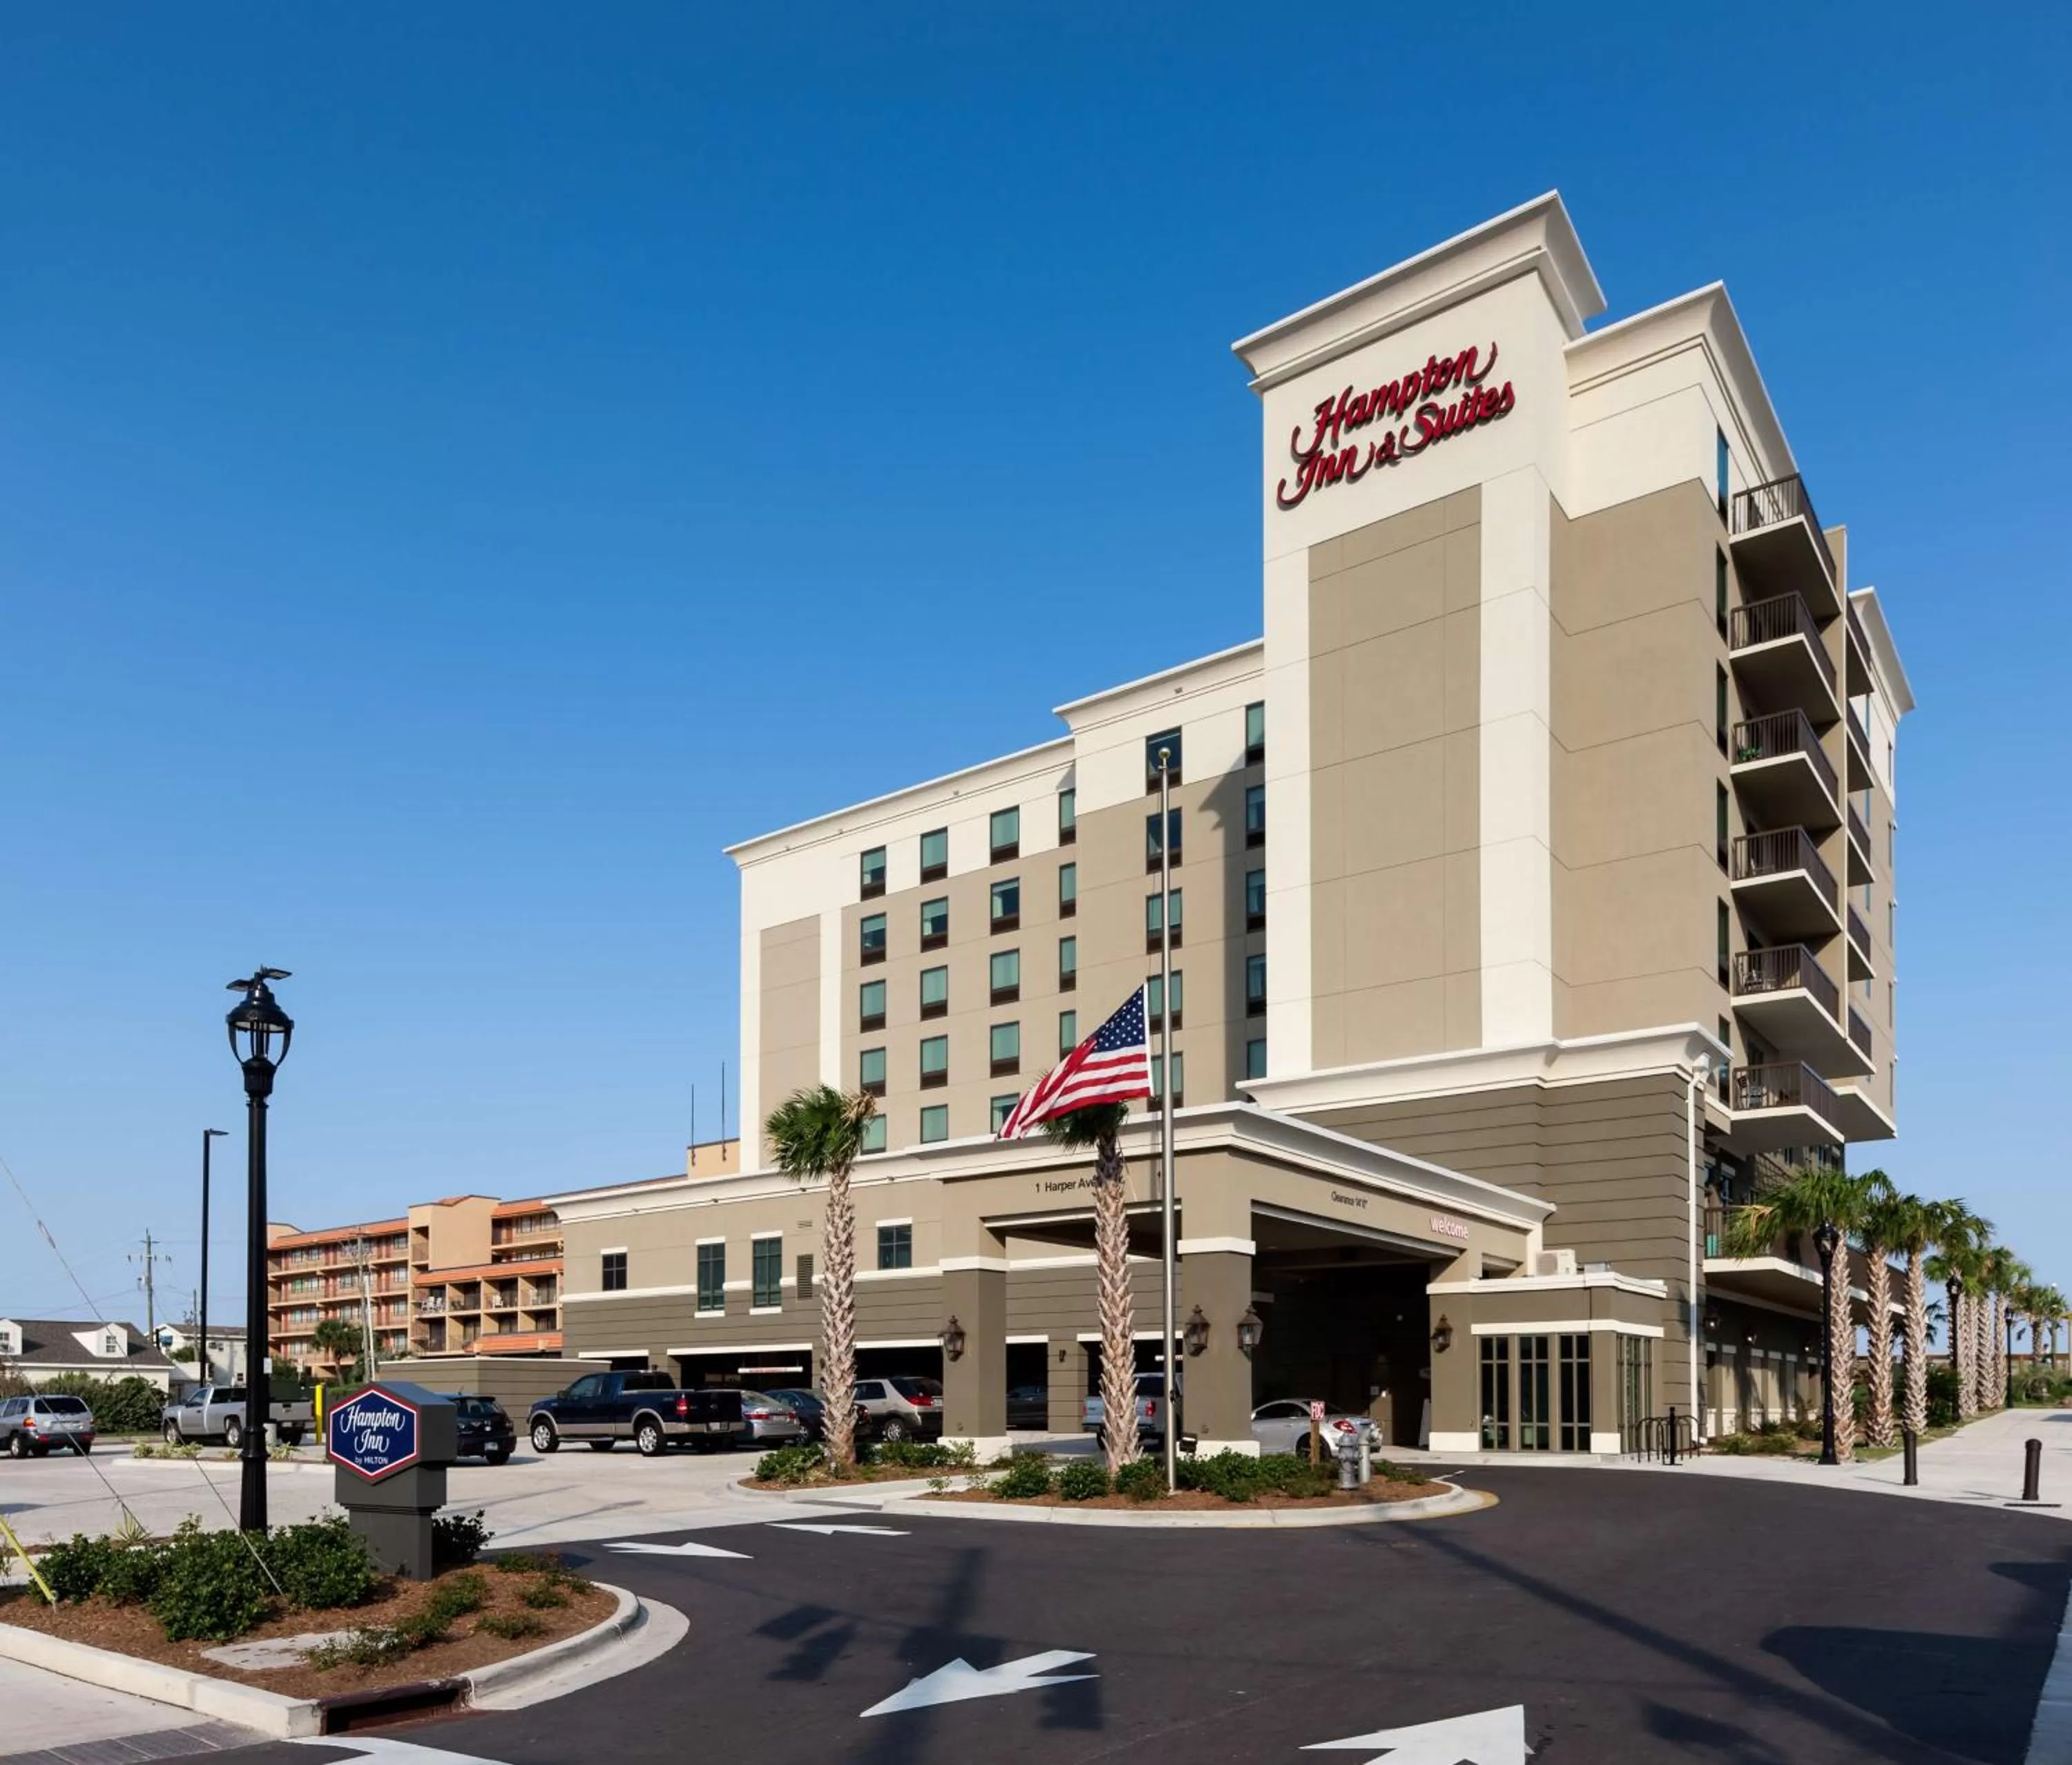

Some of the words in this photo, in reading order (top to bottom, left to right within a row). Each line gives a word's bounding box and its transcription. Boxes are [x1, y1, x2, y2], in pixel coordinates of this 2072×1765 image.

[1291, 341, 1497, 456] Hampton
[1277, 444, 1374, 505] Inn
[1376, 432, 1401, 461] &
[1400, 380, 1515, 452] Suites
[1035, 1182, 1039, 1193] 1
[1045, 1181, 1076, 1193] Harper
[1430, 1216, 1469, 1240] welcome
[339, 1405, 405, 1433] Hampton
[1312, 1402, 1324, 1420] FDC
[354, 1429, 390, 1454] Inn
[355, 1456, 362, 1465] by
